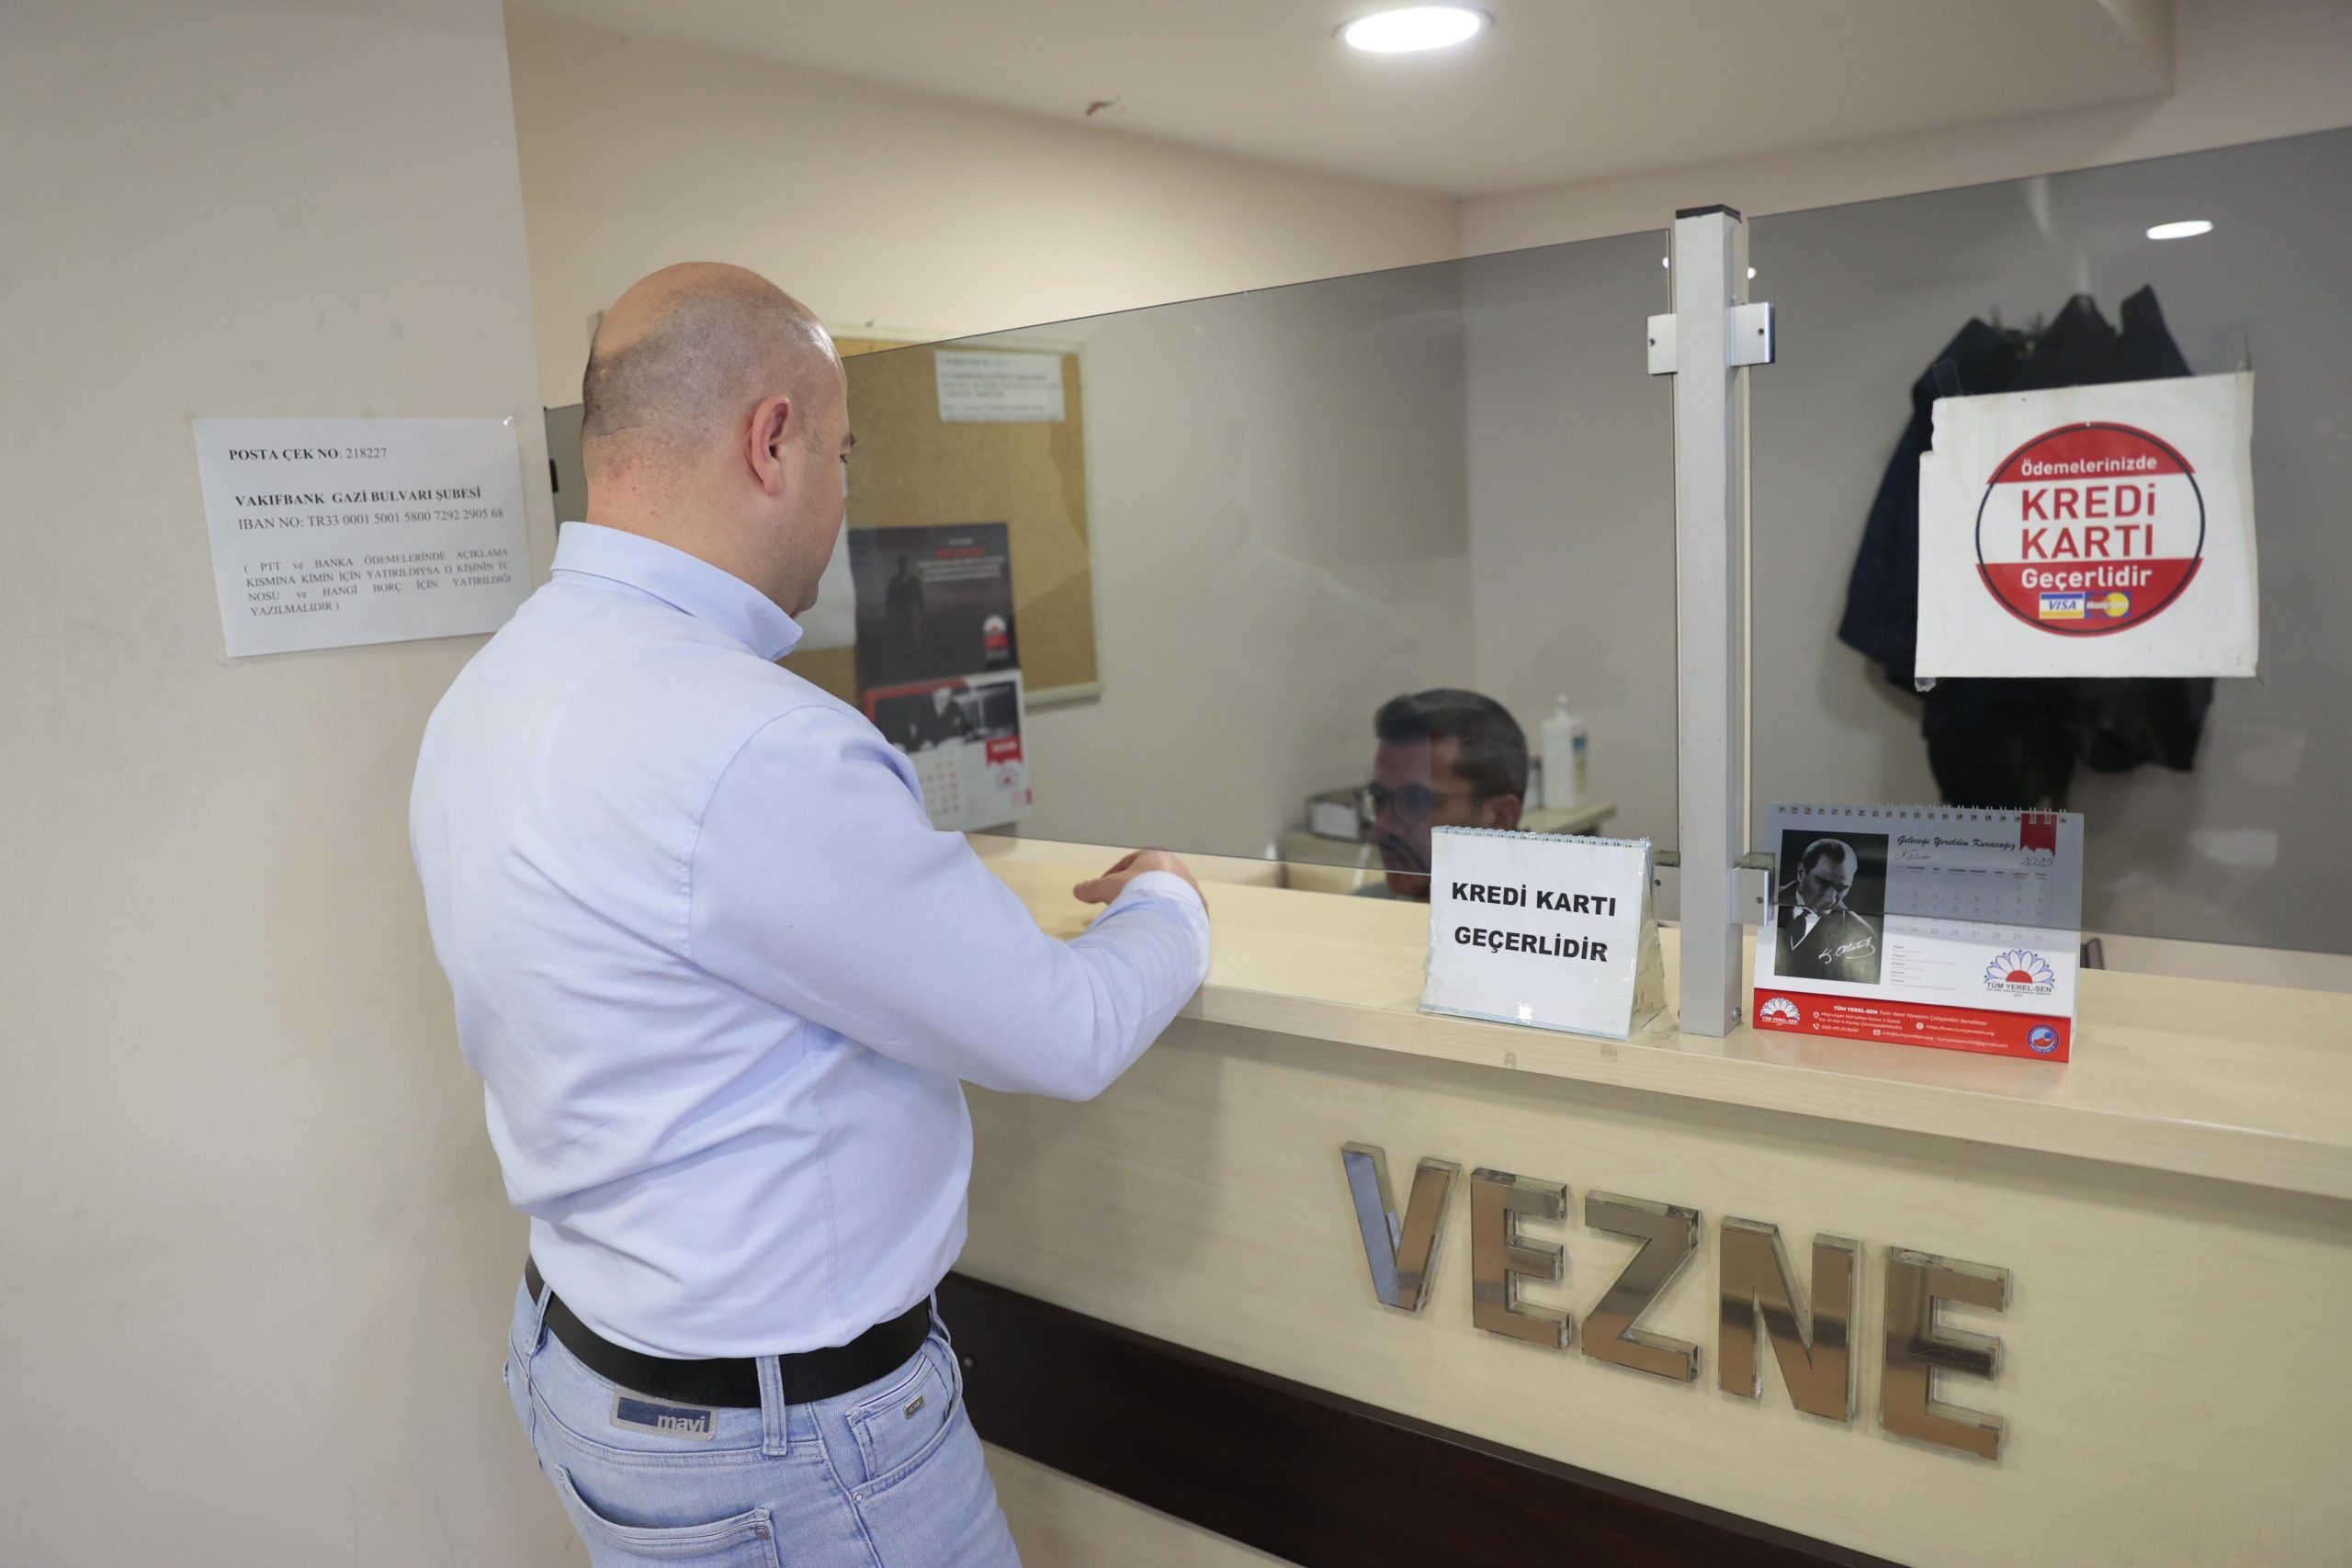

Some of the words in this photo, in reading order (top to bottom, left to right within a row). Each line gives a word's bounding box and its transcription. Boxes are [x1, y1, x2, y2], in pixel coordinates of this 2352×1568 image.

[230, 449, 278, 460] POSTA
[283, 448, 313, 461] ÇEK
[318, 448, 343, 459] NO:
[346, 447, 387, 458] 218227
[2021, 457, 2157, 477] Ödemelerinizde
[235, 493, 324, 506] VAKIFBANK
[332, 490, 367, 503] GAZİ
[371, 490, 432, 502] BULVARI
[435, 486, 481, 501] ŞUBESİ
[238, 517, 275, 530] IBAN
[279, 516, 304, 528] NO:
[307, 514, 339, 527] TR33
[343, 513, 368, 525] 0001
[374, 513, 400, 524] 5001
[404, 511, 431, 523] 5800
[434, 510, 459, 521] 7292
[463, 508, 488, 519] 2905
[491, 508, 503, 518] 68
[2021, 524, 2154, 560] KARTI
[261, 561, 281, 571] PTT
[315, 558, 354, 569] BANKA
[364, 552, 446, 566] ÖDEMELERİNDE
[457, 548, 508, 559] AÇIKLAMA
[246, 576, 296, 587] KISMINA
[301, 572, 334, 583] KİMİN
[339, 570, 361, 582] İÇİN
[367, 567, 440, 579] YATIRILDIYSA
[445, 565, 452, 573] O
[457, 562, 493, 574] KİŞİNİN
[498, 561, 510, 570] TC
[2021, 565, 2153, 591] Geçerlidir
[248, 592, 280, 602] NOSU
[322, 584, 357, 596] HANGİ
[373, 583, 401, 594] BORÇ
[417, 580, 438, 591] İÇİN
[452, 574, 511, 587] YATIRILDIĞI
[250, 602, 333, 616] YAZILMALIDIR
[2049, 600, 2076, 611] VISA
[1452, 882, 1527, 908] KREDİ
[1536, 890, 1616, 917] KARTI
[1454, 926, 1608, 963] GEÇERLİDİR
[2007, 983, 2052, 992] YEREL-SEN
[1340, 1140, 2009, 1461] VEZNE
[658, 1415, 706, 1433] mavi
